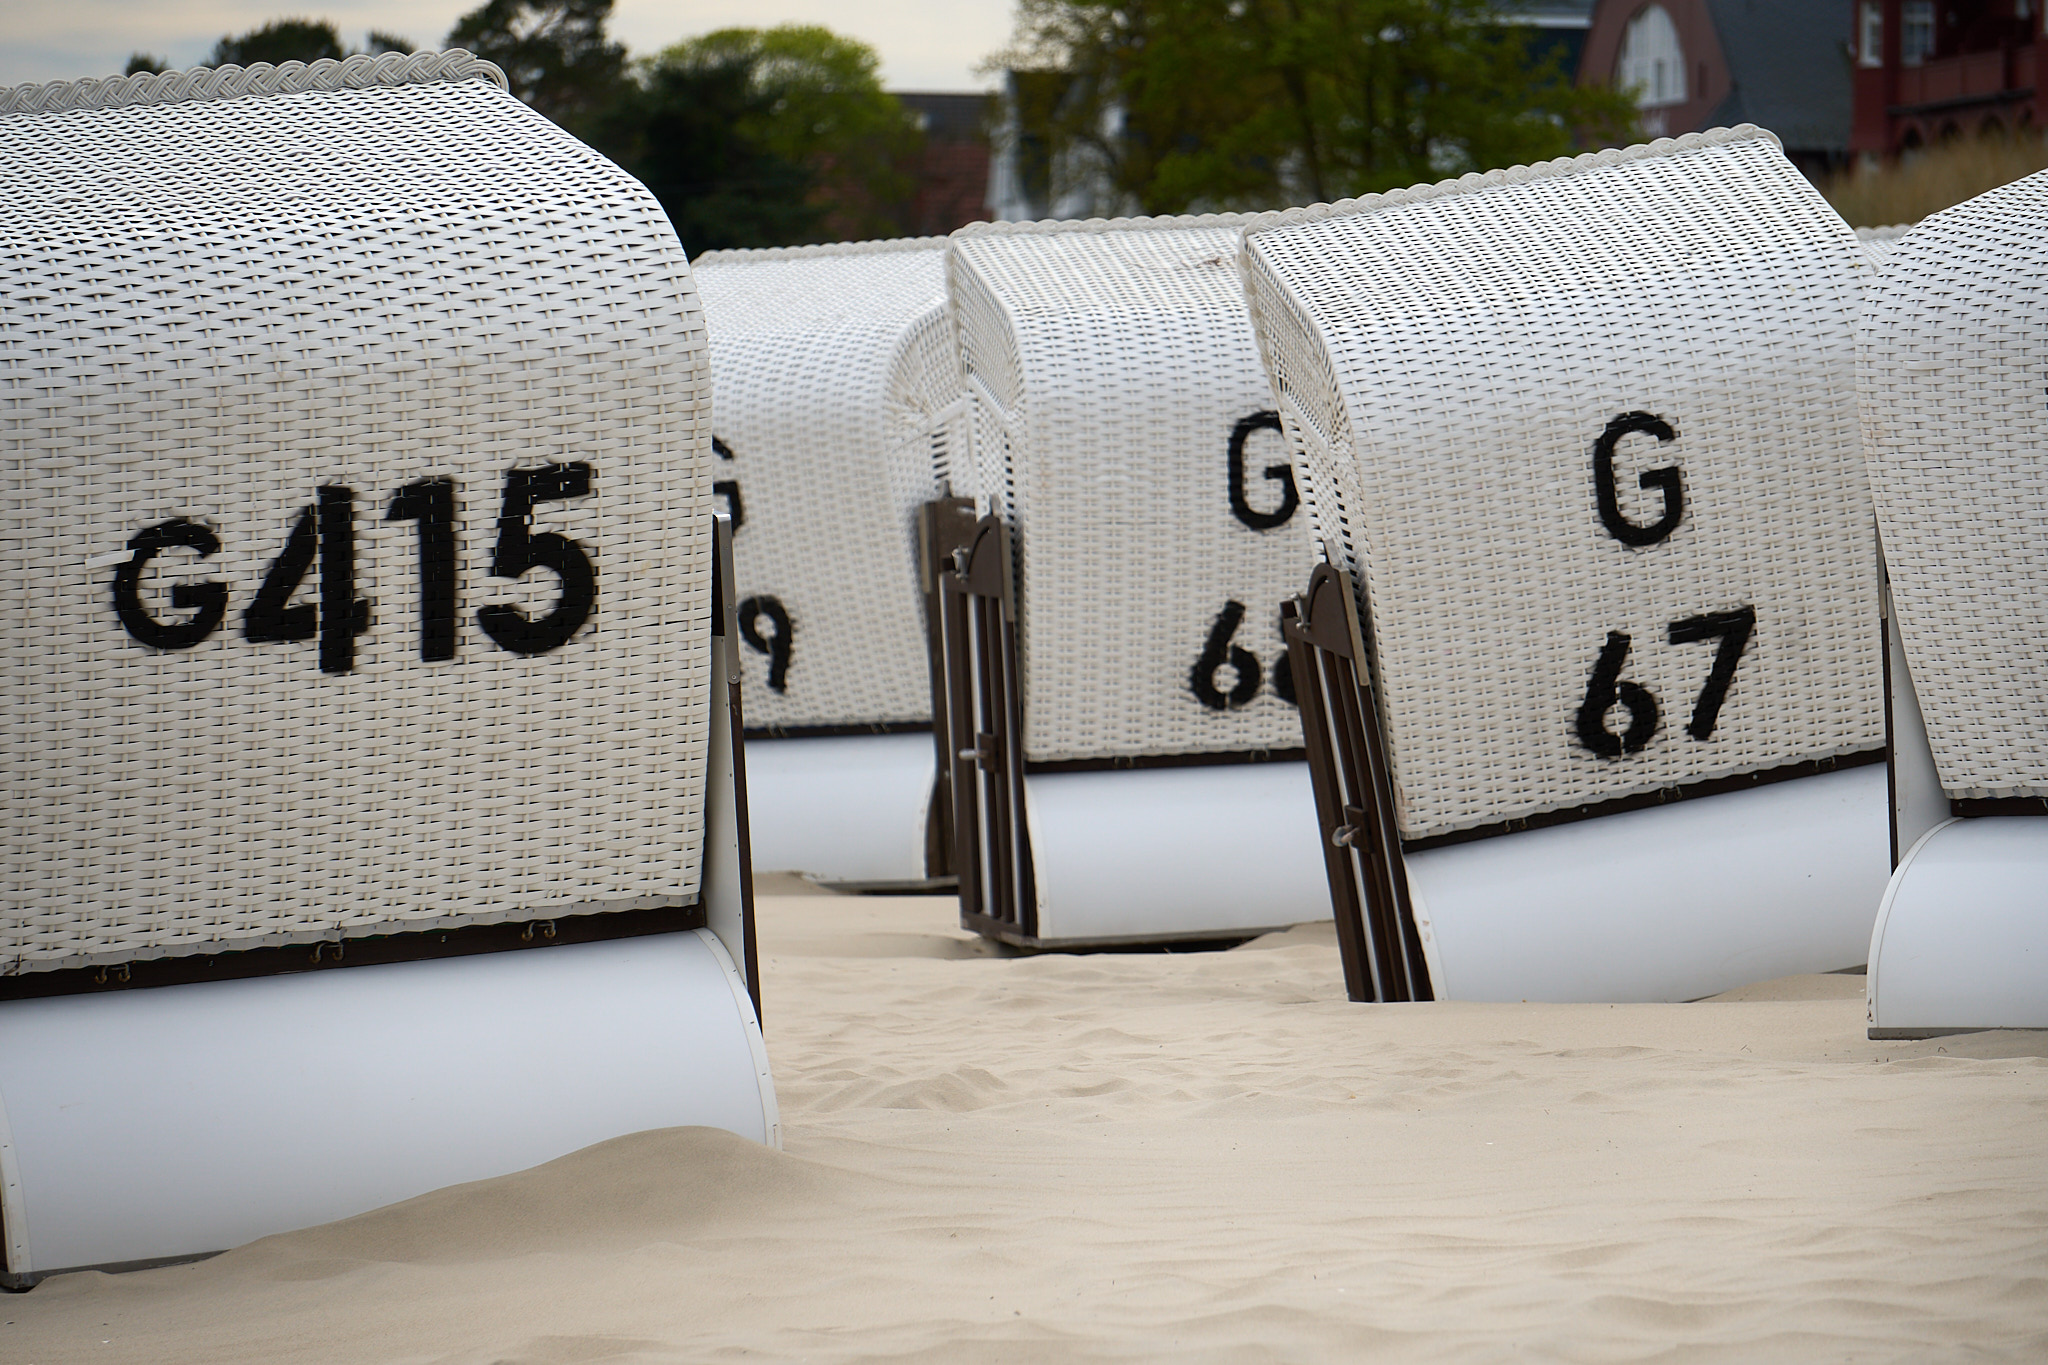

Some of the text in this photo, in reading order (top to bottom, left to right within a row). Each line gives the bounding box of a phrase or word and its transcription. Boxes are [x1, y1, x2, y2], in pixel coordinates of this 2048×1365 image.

[1228, 410, 1300, 530] G
[1594, 410, 1683, 546] G
[112, 461, 597, 673] G415
[1576, 603, 1756, 760] 67
